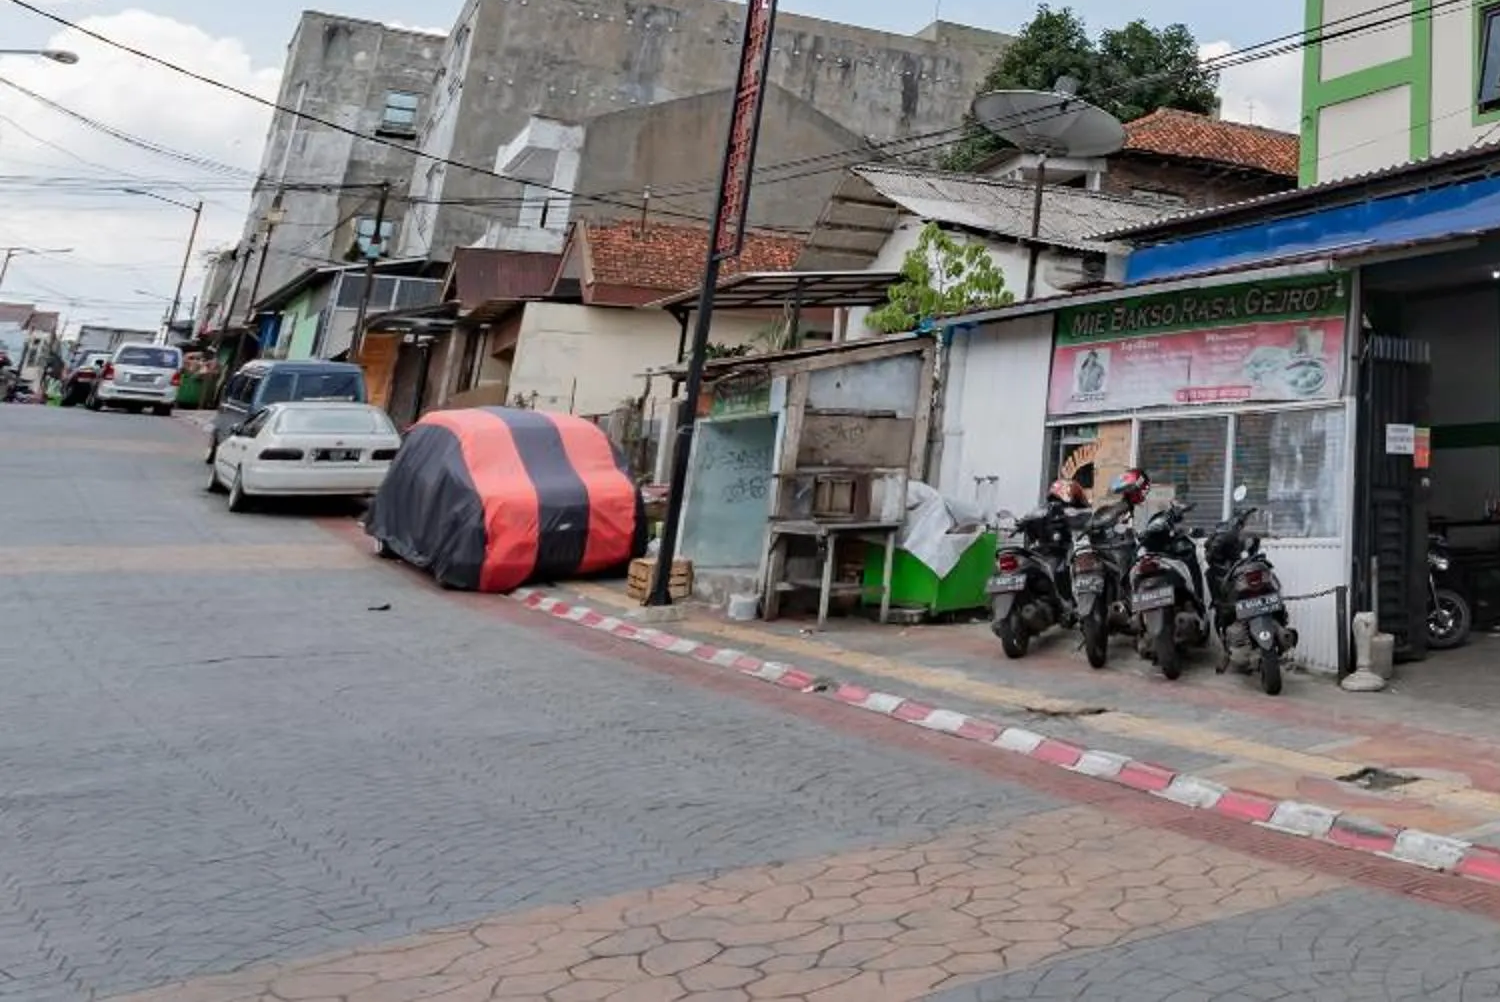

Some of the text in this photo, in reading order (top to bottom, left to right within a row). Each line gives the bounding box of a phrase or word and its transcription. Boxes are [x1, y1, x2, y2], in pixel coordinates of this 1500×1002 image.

[1071, 285, 1333, 338] MIE BAKSO RASA GEJROT
